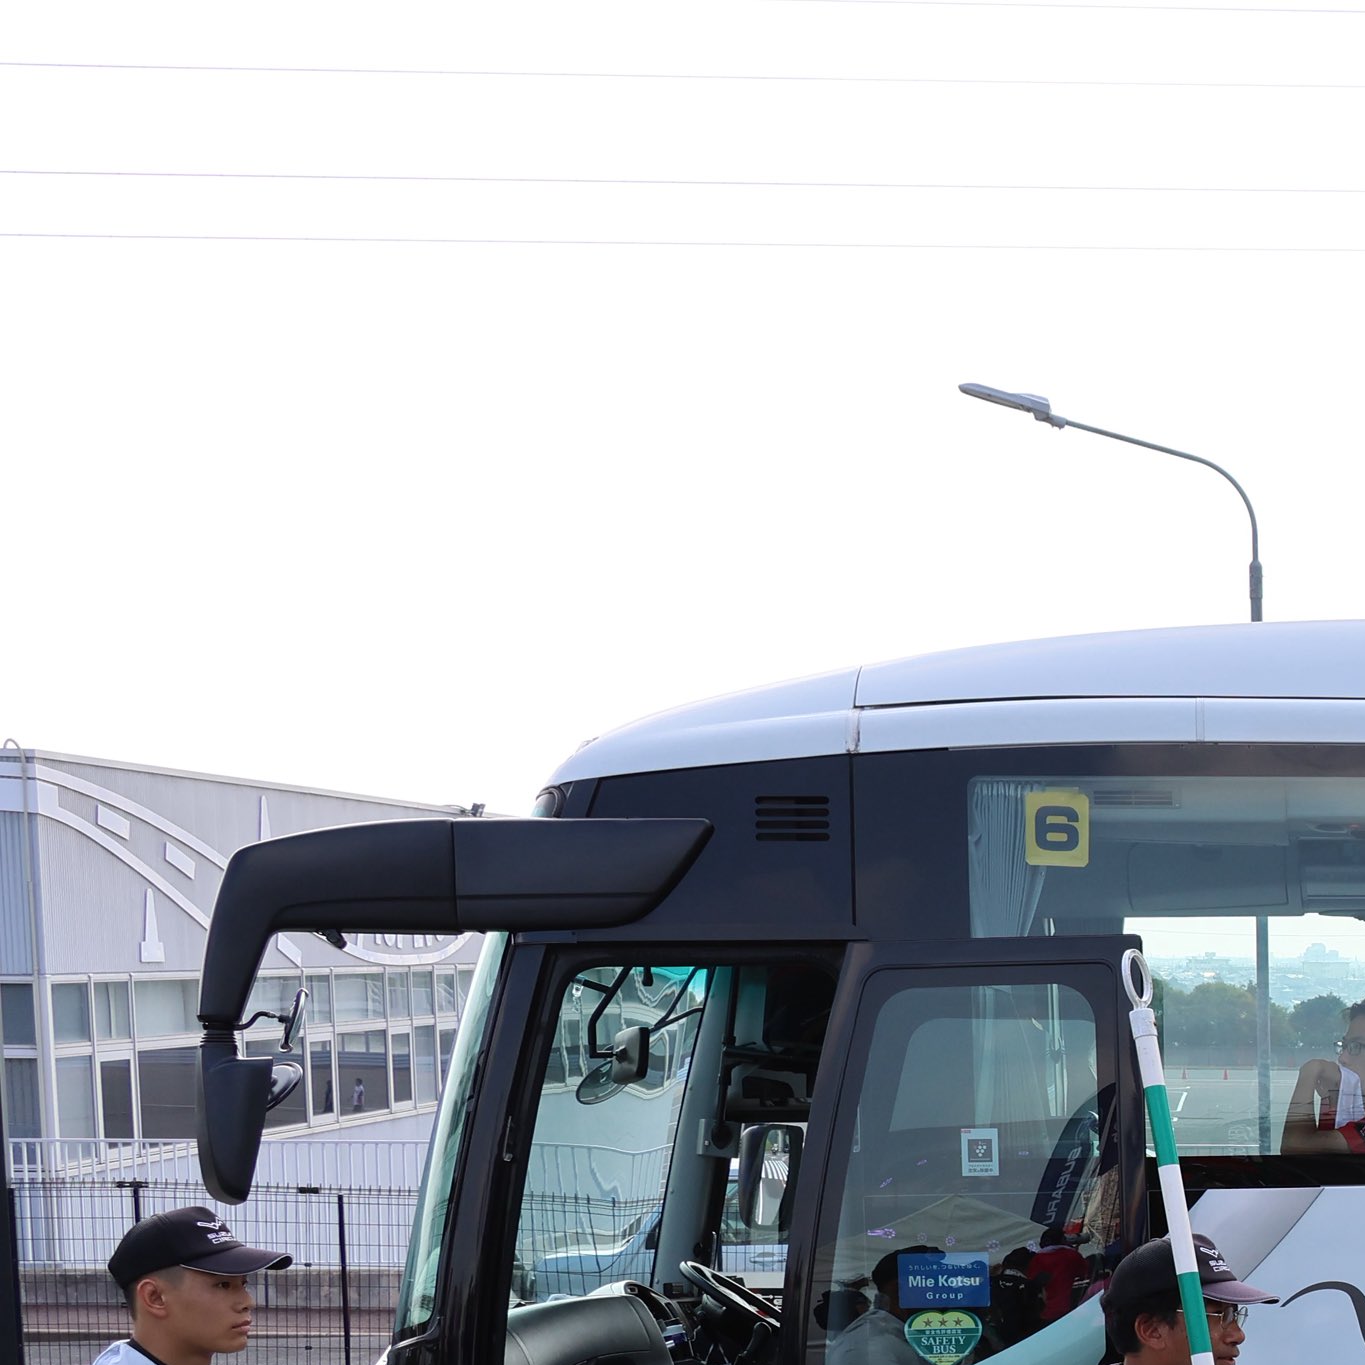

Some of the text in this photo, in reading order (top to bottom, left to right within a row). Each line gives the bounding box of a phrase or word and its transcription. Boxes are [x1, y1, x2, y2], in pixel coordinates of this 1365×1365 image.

[1035, 806, 1079, 851] 6
[908, 1274, 980, 1288] Mie Kotsu
[926, 1292, 963, 1300] Group
[921, 1336, 966, 1346] SAFETY
[933, 1345, 956, 1354] BUS
